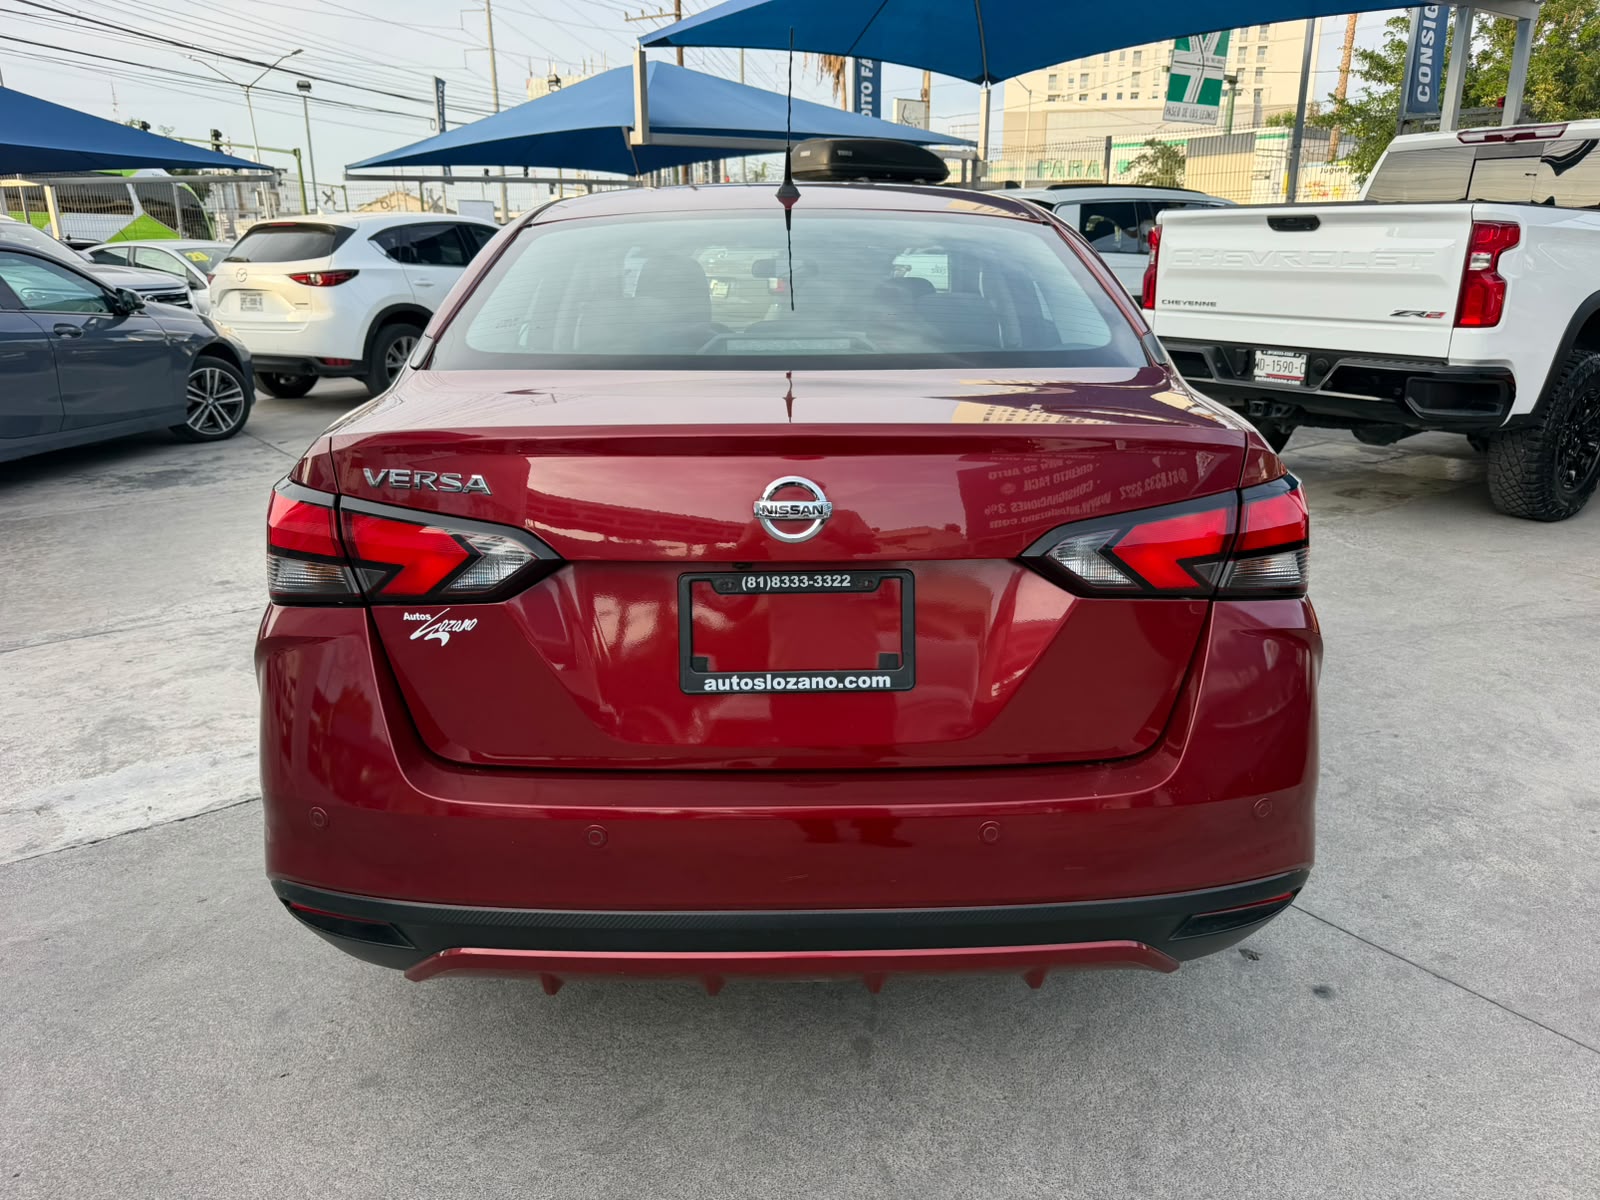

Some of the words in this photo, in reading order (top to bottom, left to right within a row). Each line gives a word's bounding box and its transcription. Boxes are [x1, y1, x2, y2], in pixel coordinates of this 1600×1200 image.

[1417, 5, 1439, 103] CONSIG
[1165, 105, 1181, 117] PASEO
[1182, 106, 1189, 118] DE
[1171, 248, 1436, 270] CHEVROLET
[1161, 298, 1217, 308] CHEYENNE
[1389, 309, 1447, 319] ZR2
[363, 467, 493, 496] VERSA
[761, 504, 824, 515] NISSAN
[741, 574, 851, 591] (81)8333-3322
[403, 611, 431, 621] Autos
[704, 673, 891, 691] autoslozano.com
